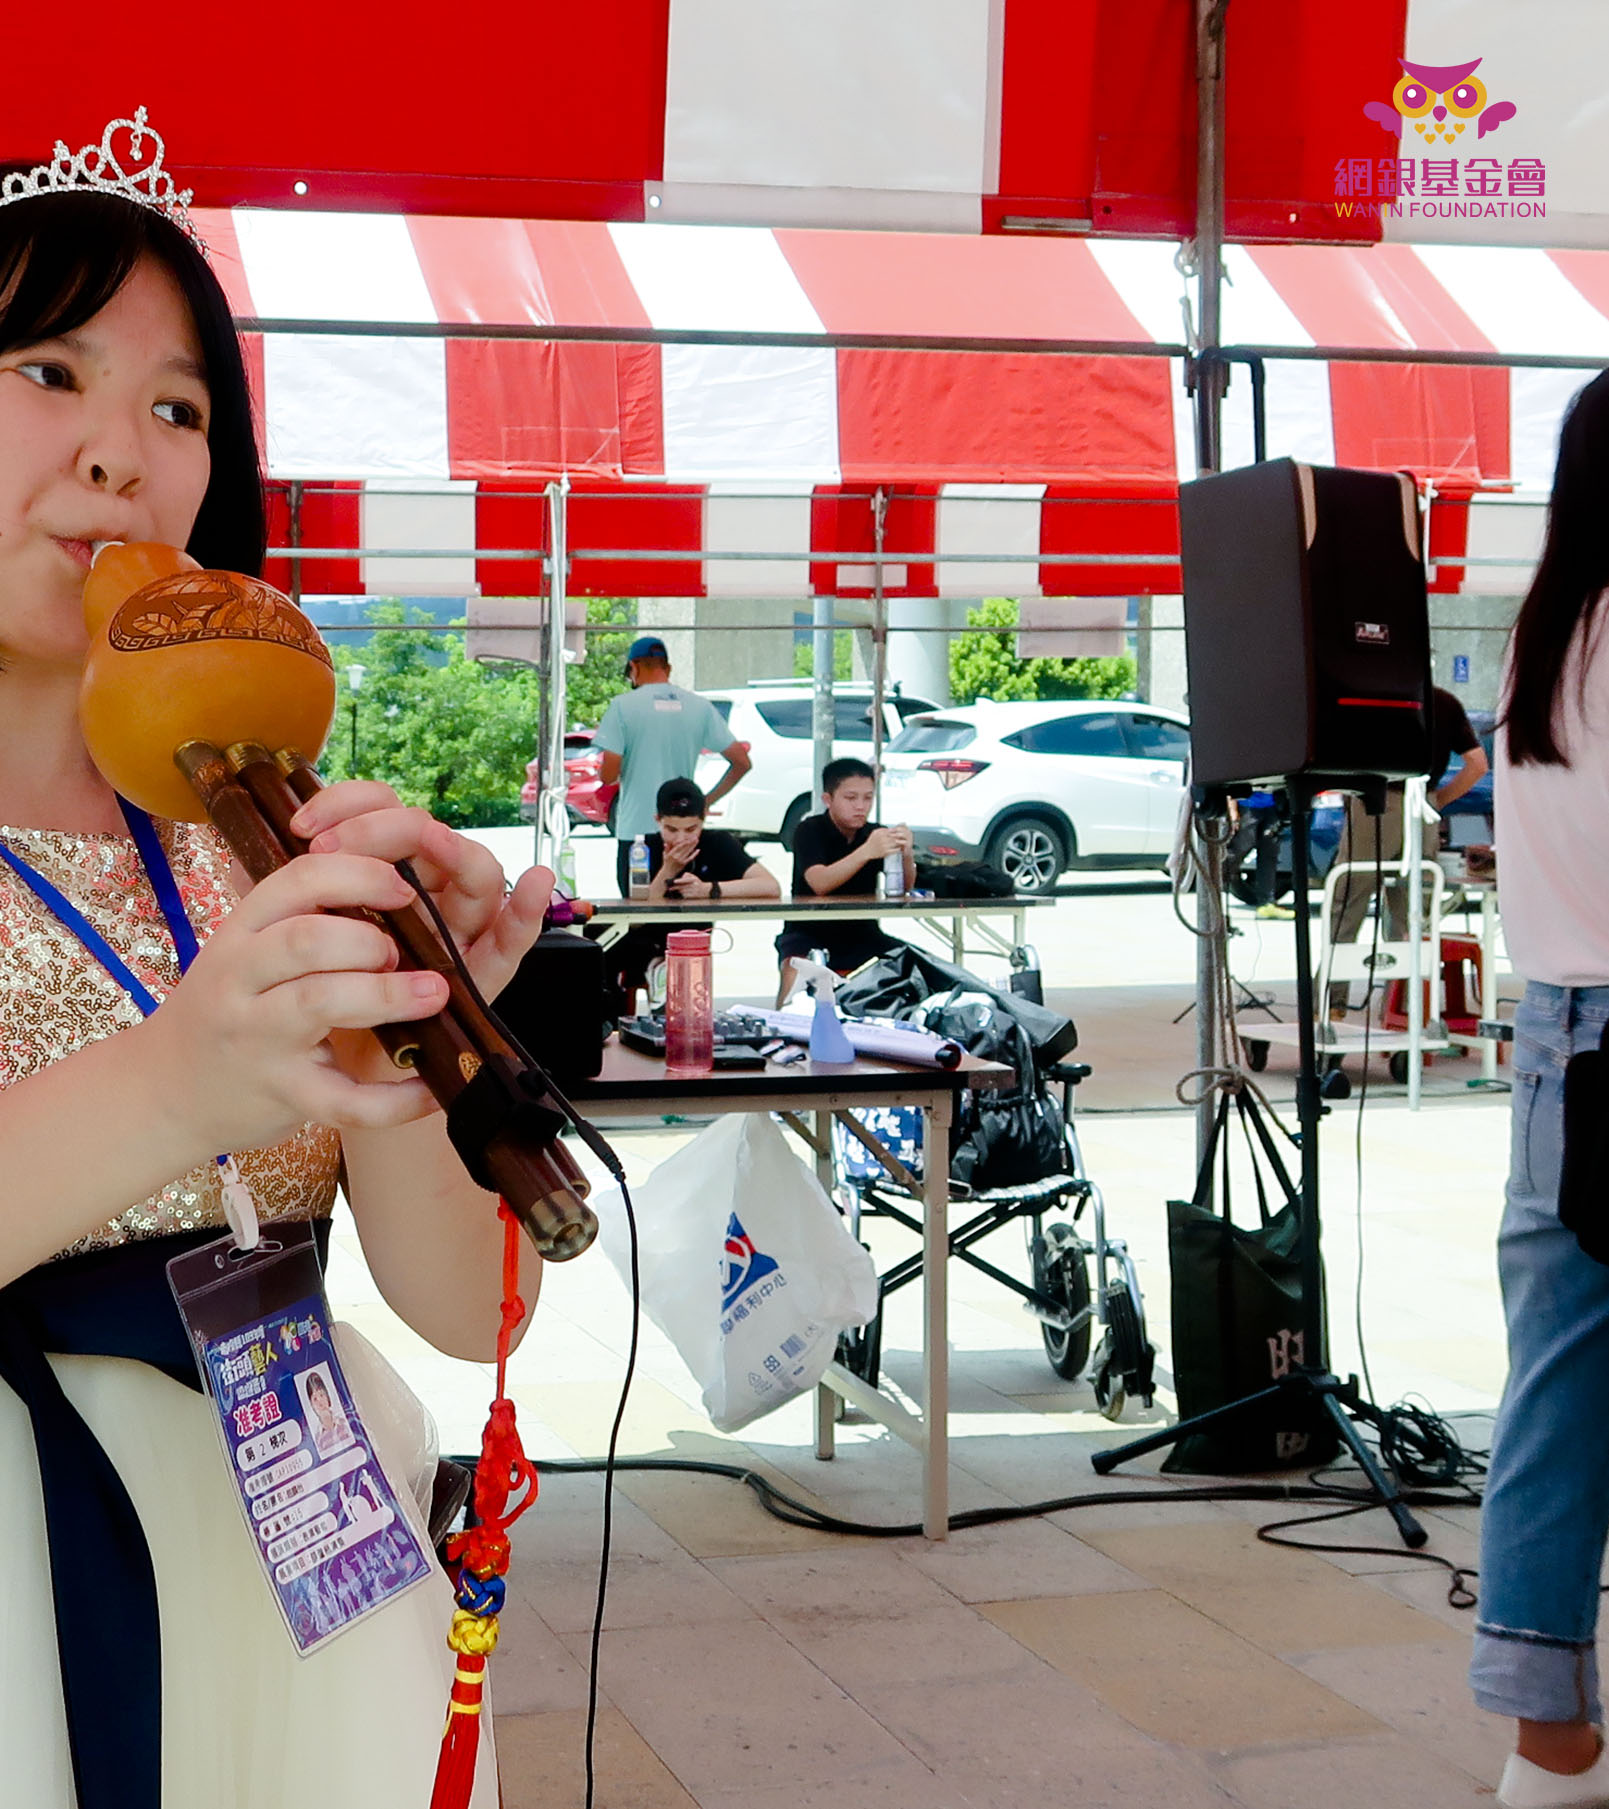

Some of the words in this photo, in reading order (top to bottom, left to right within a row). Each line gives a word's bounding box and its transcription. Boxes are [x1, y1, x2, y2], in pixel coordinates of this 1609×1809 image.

[220, 1342, 279, 1386] 街頭藝人
[259, 1444, 266, 1457] 2
